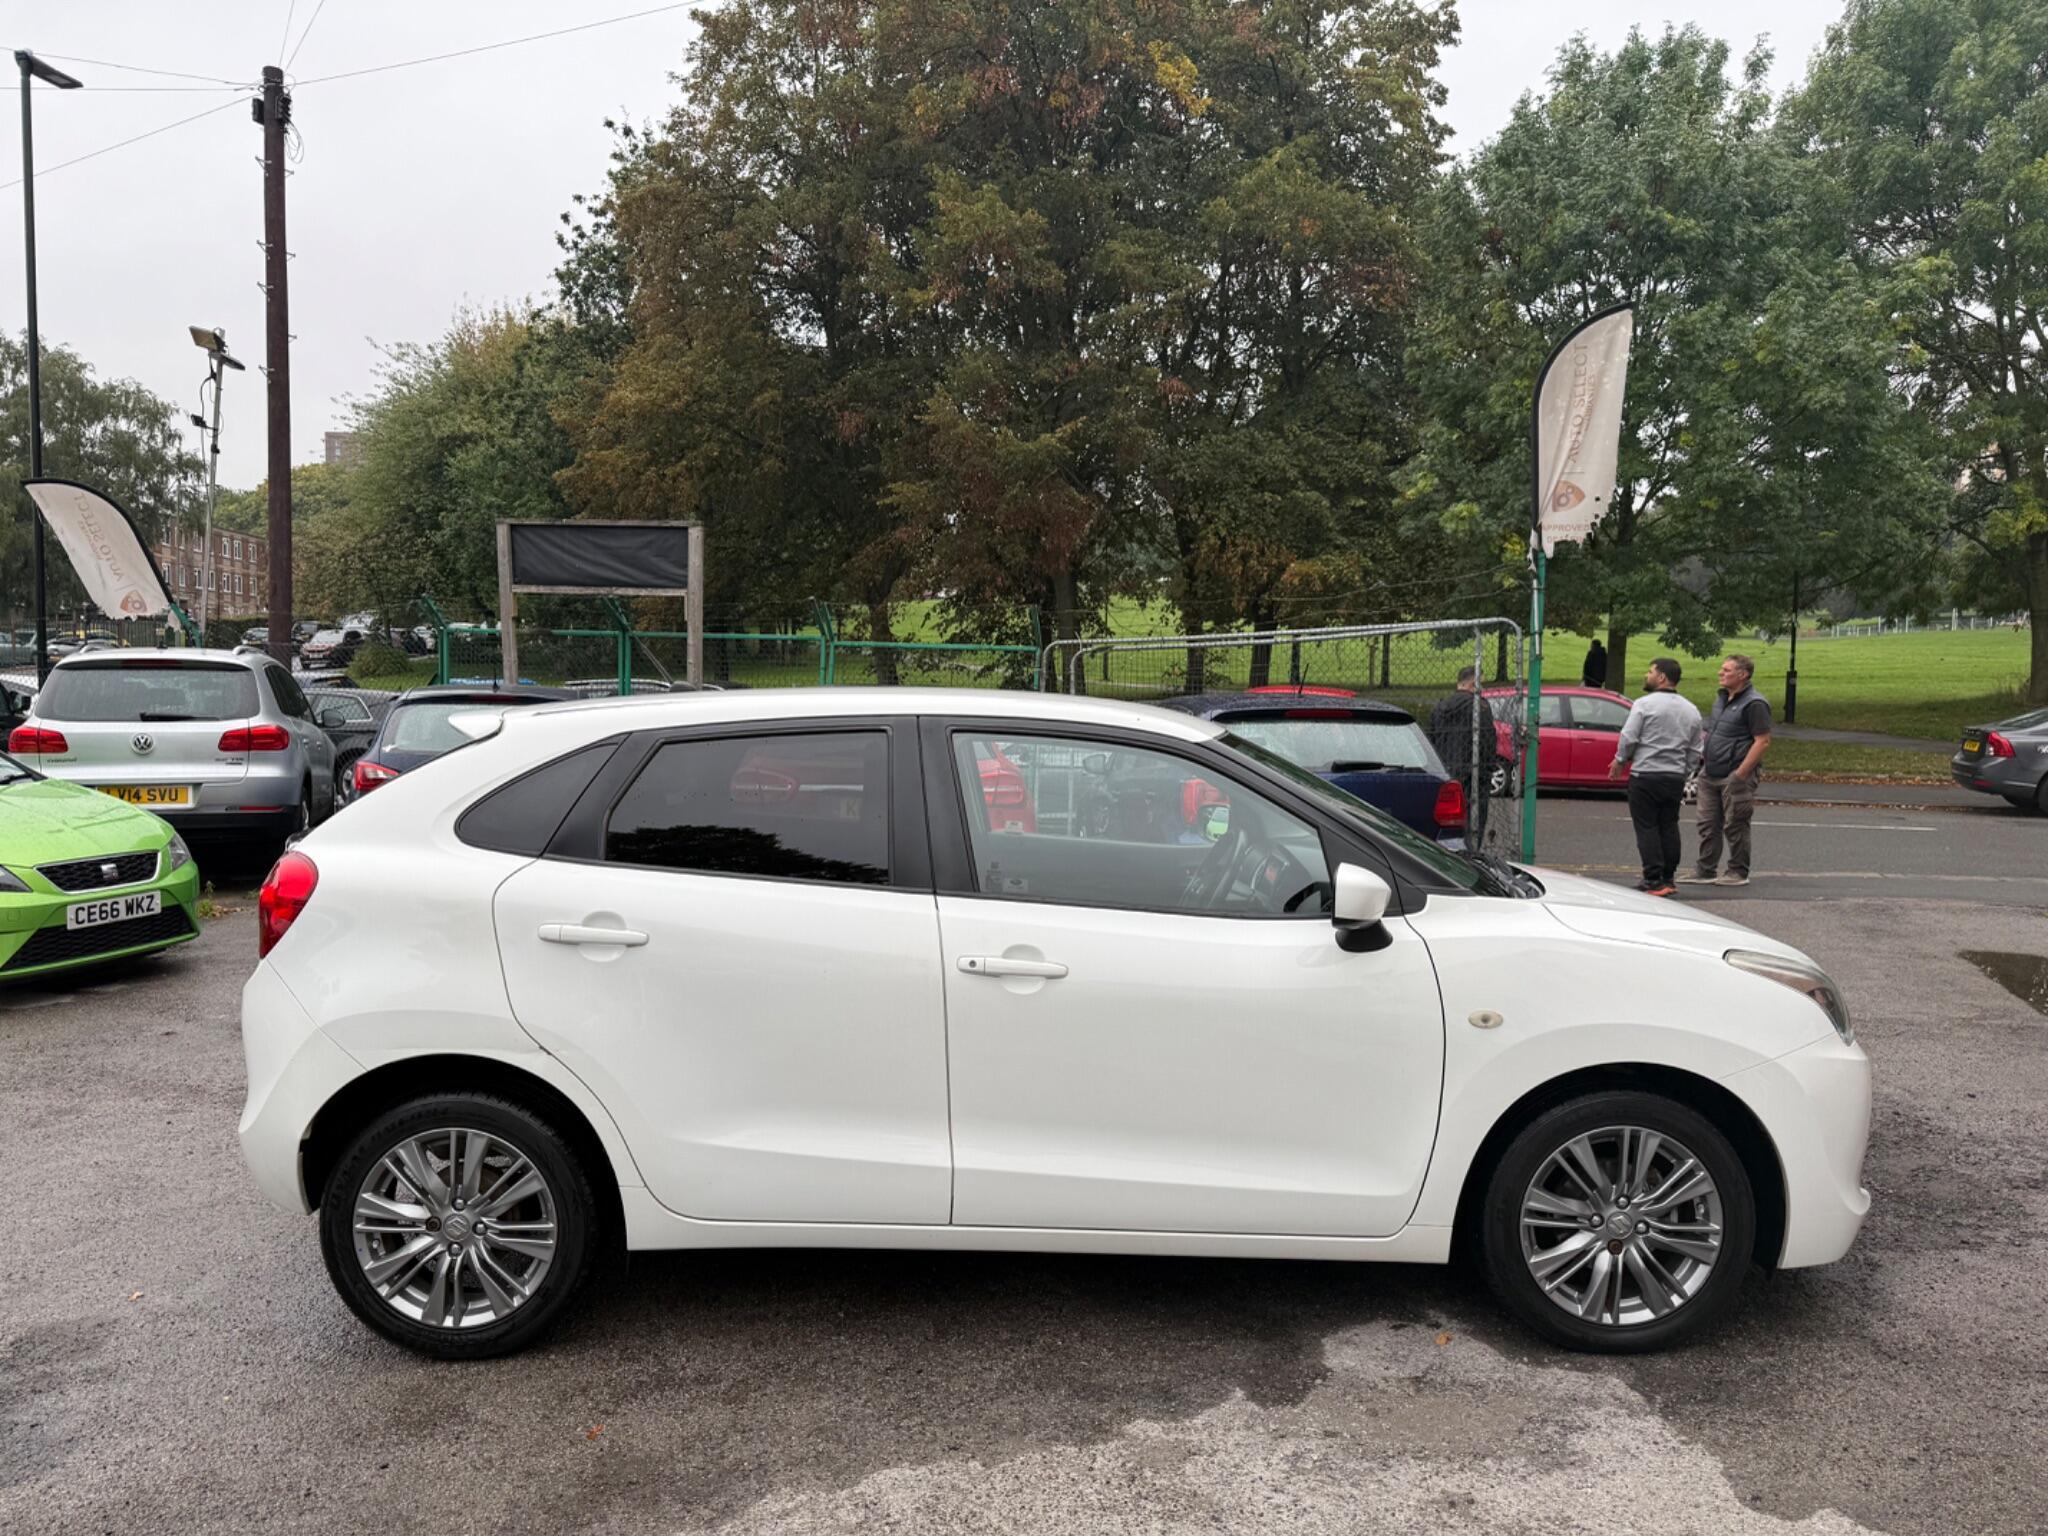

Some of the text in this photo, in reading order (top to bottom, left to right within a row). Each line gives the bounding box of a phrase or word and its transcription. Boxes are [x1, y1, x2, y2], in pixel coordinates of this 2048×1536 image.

[1573, 343, 1588, 408] SELECT
[147, 788, 178, 801] SVU
[75, 895, 155, 925] CE66 WKZ
